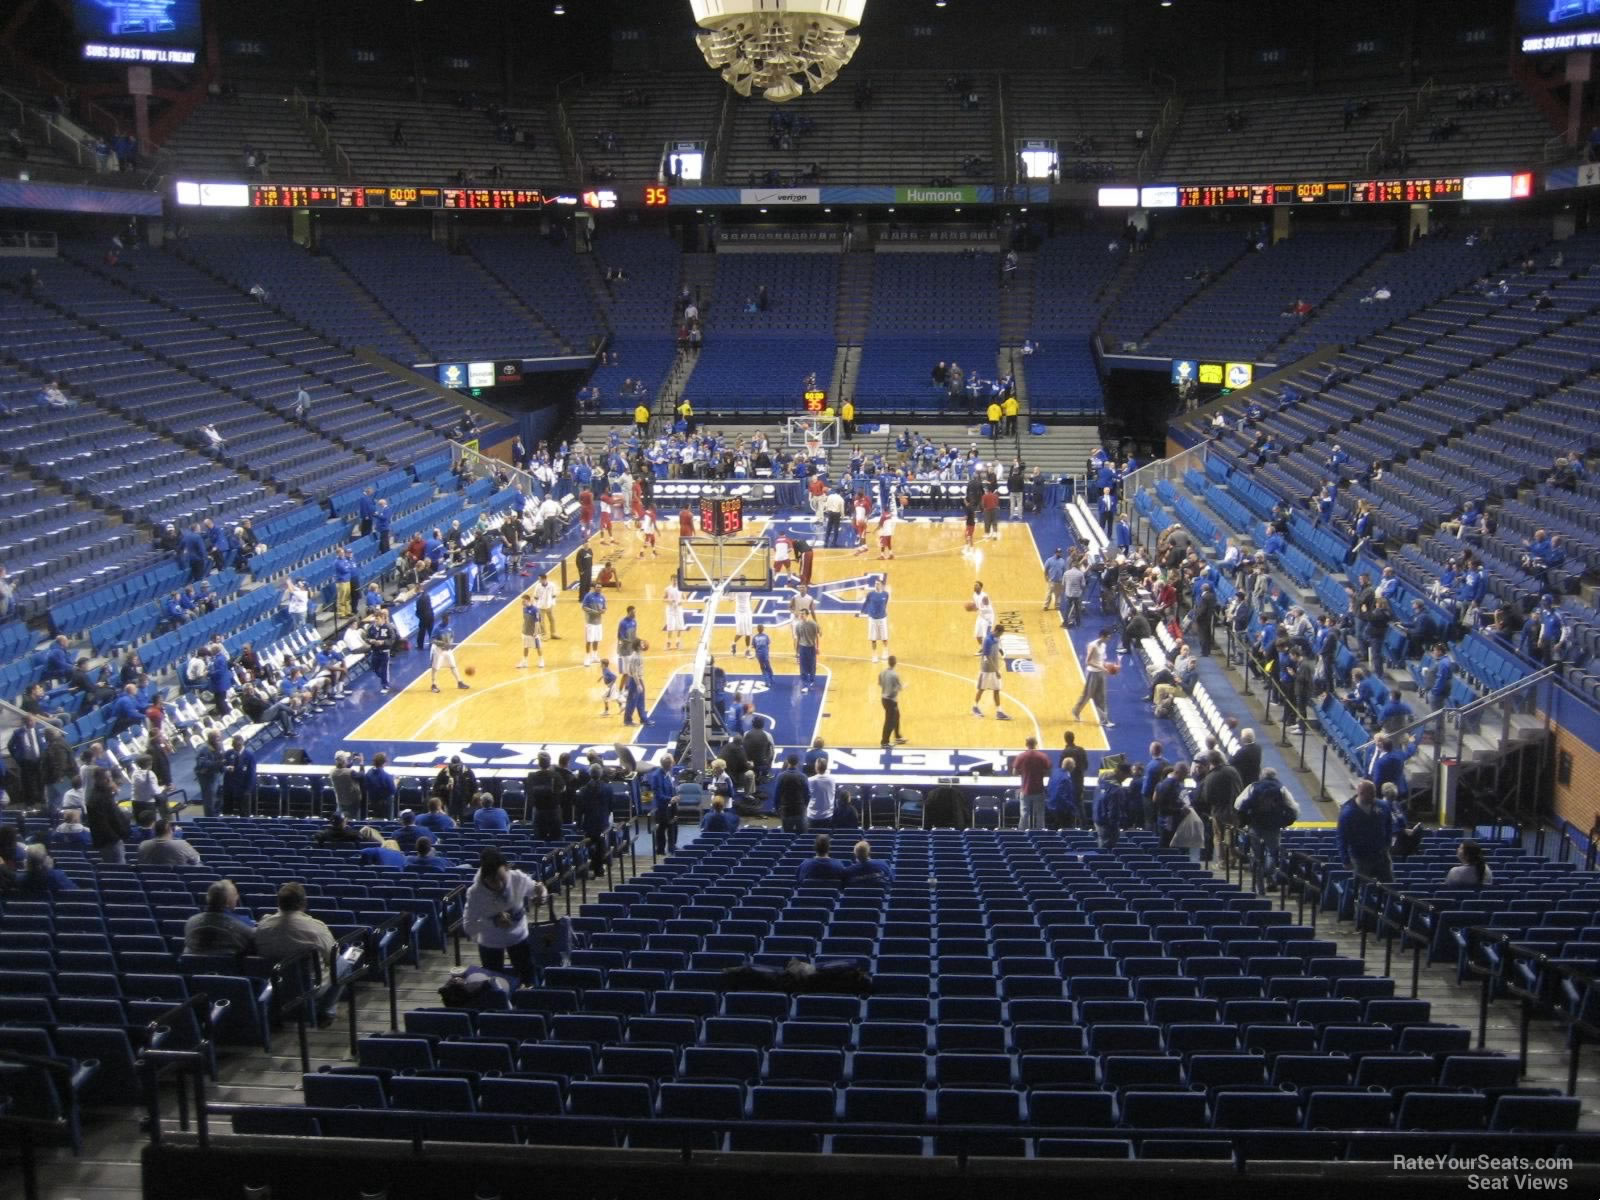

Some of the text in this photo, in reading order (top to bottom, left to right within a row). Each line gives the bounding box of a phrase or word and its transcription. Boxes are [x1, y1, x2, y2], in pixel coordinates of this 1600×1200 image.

[1555, 35, 1575, 48] FAST
[1576, 32, 1600, 46] YOU'L
[109, 47, 120, 58] SO
[121, 47, 140, 60] FAST
[390, 188, 417, 200] 60:00
[646, 188, 667, 204] 35
[777, 194, 807, 202] verizon
[907, 189, 962, 202] Humana
[807, 400, 823, 411] 35
[723, 511, 739, 532] 35
[999, 611, 1024, 633] ARENA
[380, 628, 388, 637] K
